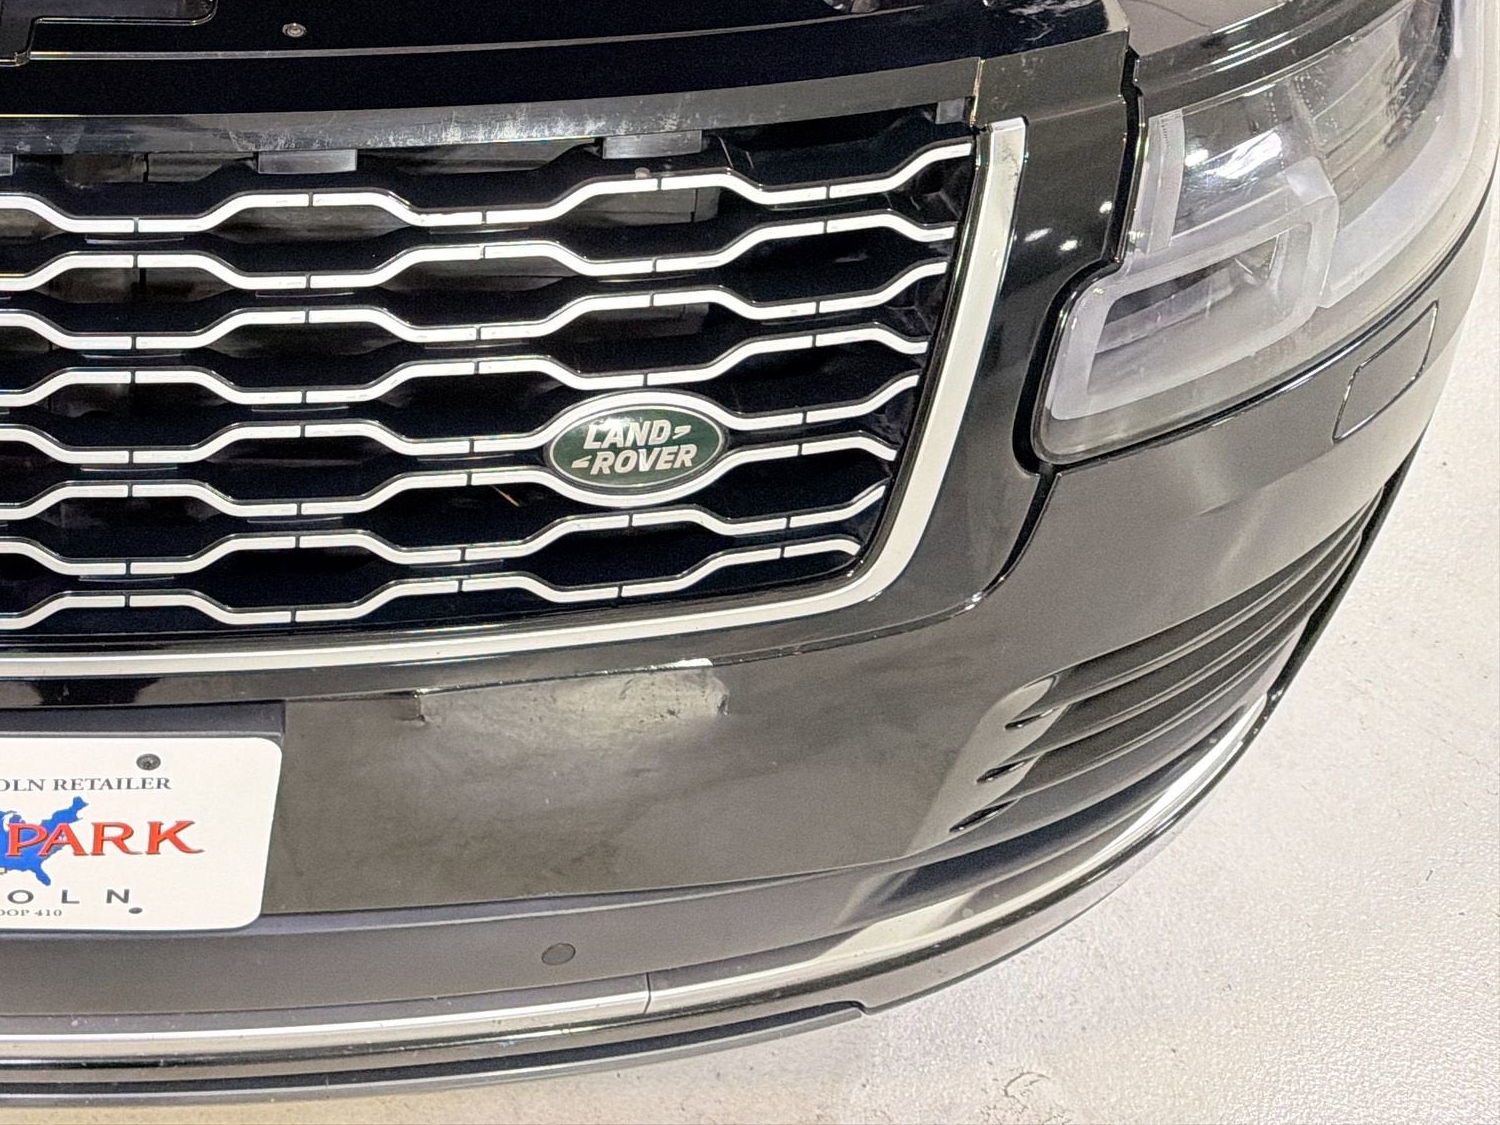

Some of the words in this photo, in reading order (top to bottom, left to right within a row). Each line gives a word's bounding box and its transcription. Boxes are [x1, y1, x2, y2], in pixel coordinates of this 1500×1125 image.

[583, 419, 671, 450] LAND
[590, 444, 698, 475] ROVER
[53, 777, 172, 792] RETAILER
[5, 820, 206, 858] PARK
[34, 908, 63, 917] 410
